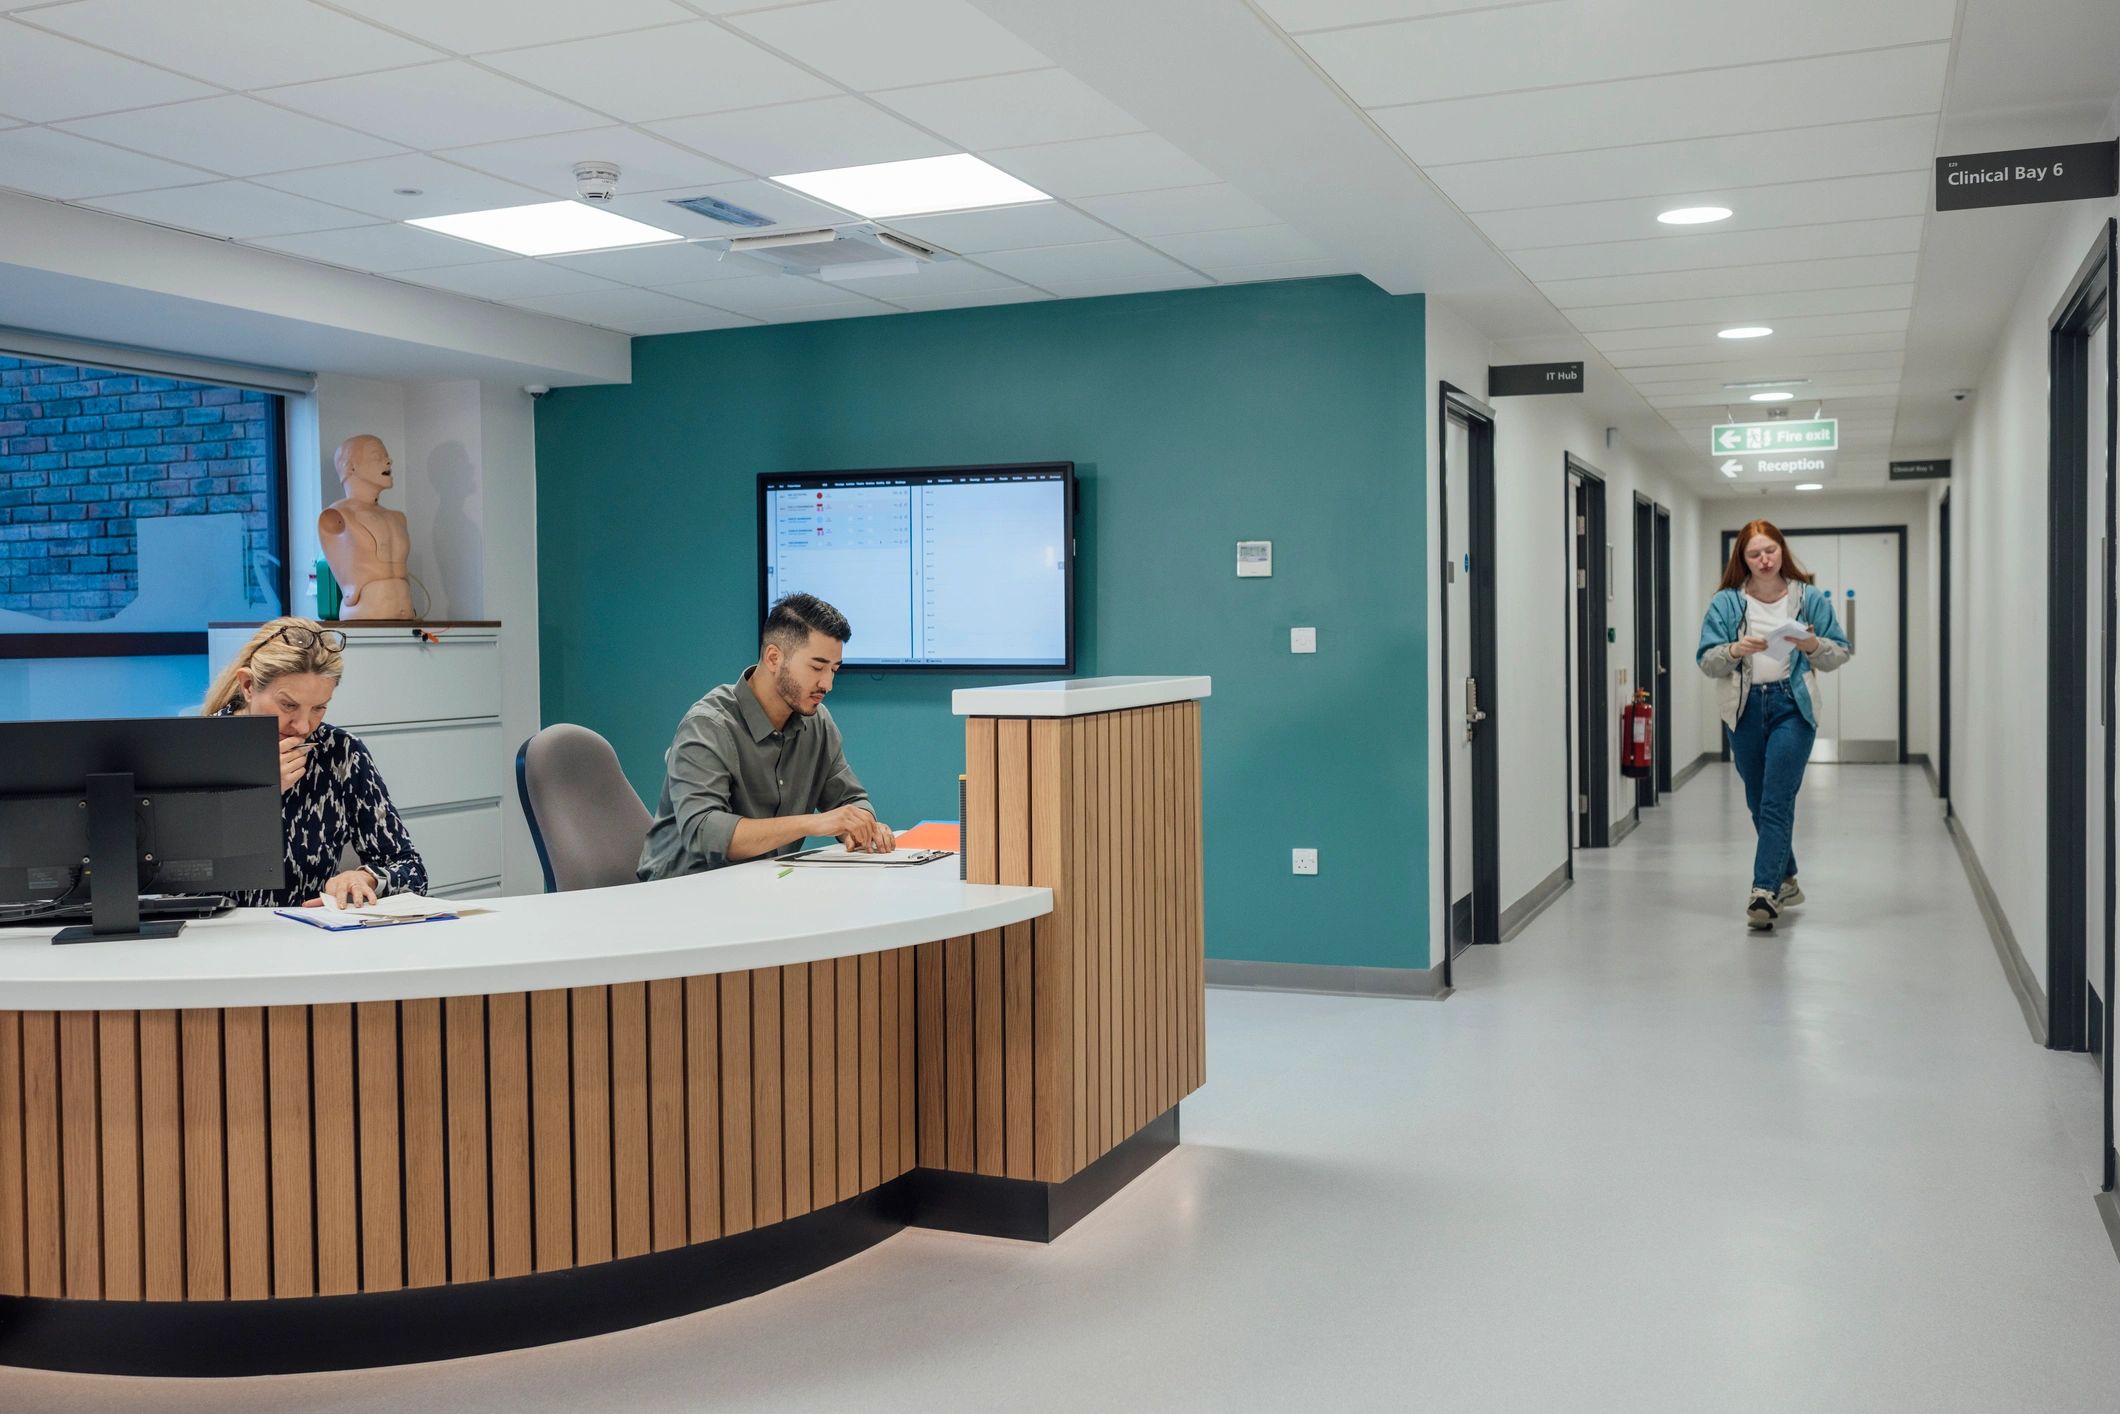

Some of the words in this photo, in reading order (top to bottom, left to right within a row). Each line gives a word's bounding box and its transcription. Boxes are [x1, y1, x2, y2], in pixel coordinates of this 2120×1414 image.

[1948, 167, 2009, 185] Clinical
[2015, 166, 2047, 181] Bay
[2053, 163, 2063, 176] 6
[1546, 372, 1556, 381] IT
[1558, 371, 1577, 380] Hub
[1777, 431, 1802, 443] Fire
[1805, 429, 1830, 441] exit
[1758, 457, 1825, 474] Reception
